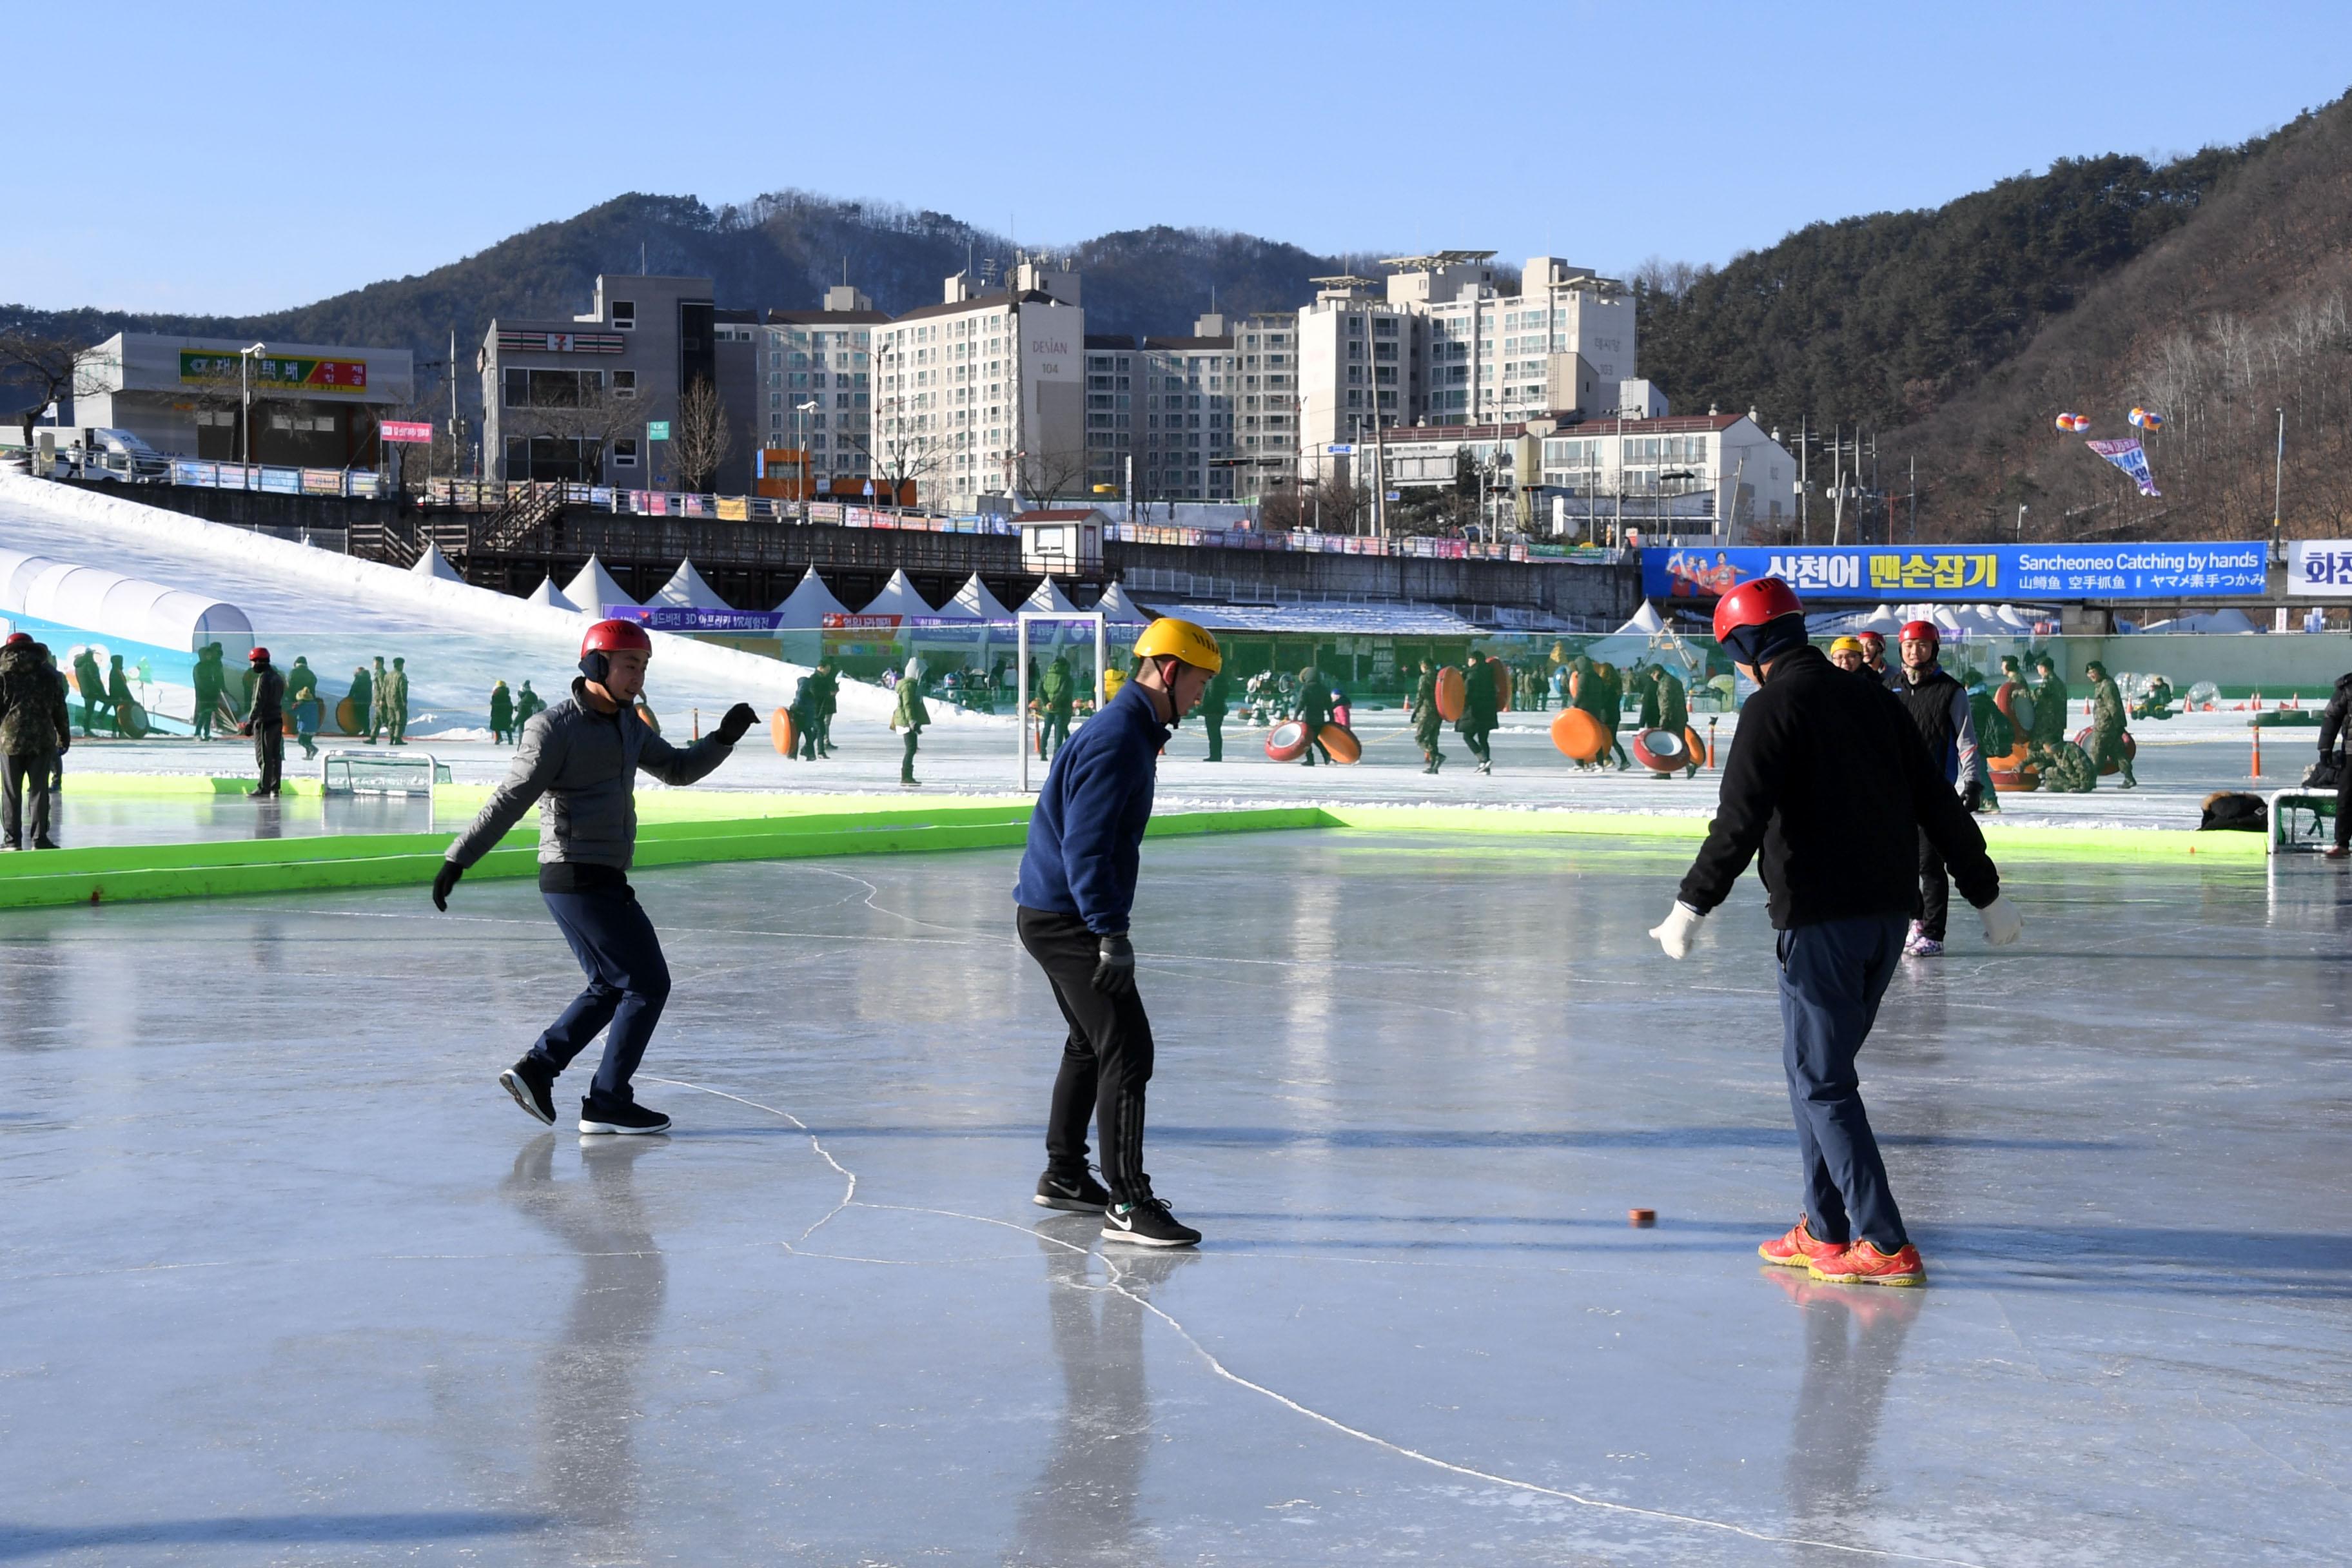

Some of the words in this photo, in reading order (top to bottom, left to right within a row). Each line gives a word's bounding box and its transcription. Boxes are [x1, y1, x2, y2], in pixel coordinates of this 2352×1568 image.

[1042, 364, 1059, 374] 104
[1765, 556, 1859, 588] 산천어
[1869, 554, 1996, 589] 맨손잡기
[2019, 554, 2113, 571] Sancheoneo
[2116, 553, 2184, 572] Catching
[2188, 552, 2207, 573] by
[2209, 551, 2258, 569] hands
[651, 612, 681, 626] 월드비전
[685, 613, 696, 625] 3D
[698, 614, 730, 629] 아프리카
